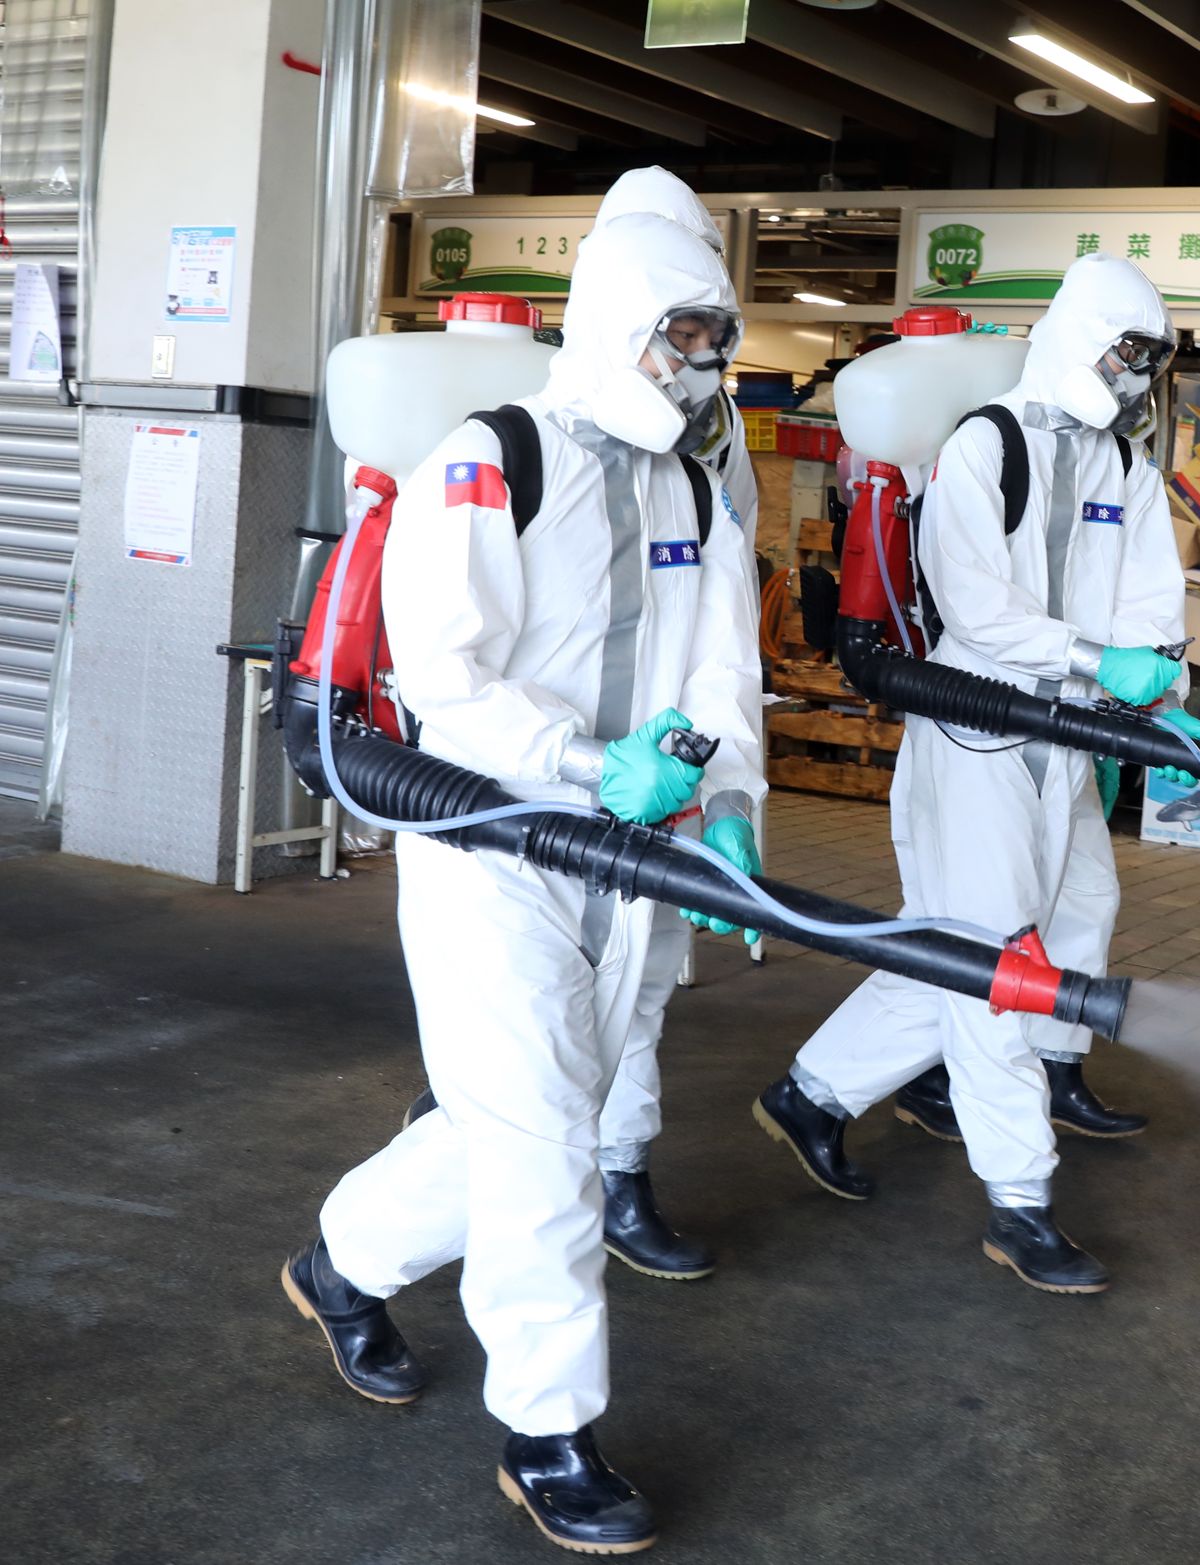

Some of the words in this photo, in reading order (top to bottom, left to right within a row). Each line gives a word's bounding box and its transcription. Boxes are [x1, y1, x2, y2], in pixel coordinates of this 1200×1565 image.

[516, 233, 588, 255] 123
[436, 248, 467, 263] 0105
[935, 248, 977, 265] 0072
[657, 545, 695, 562] 消除
